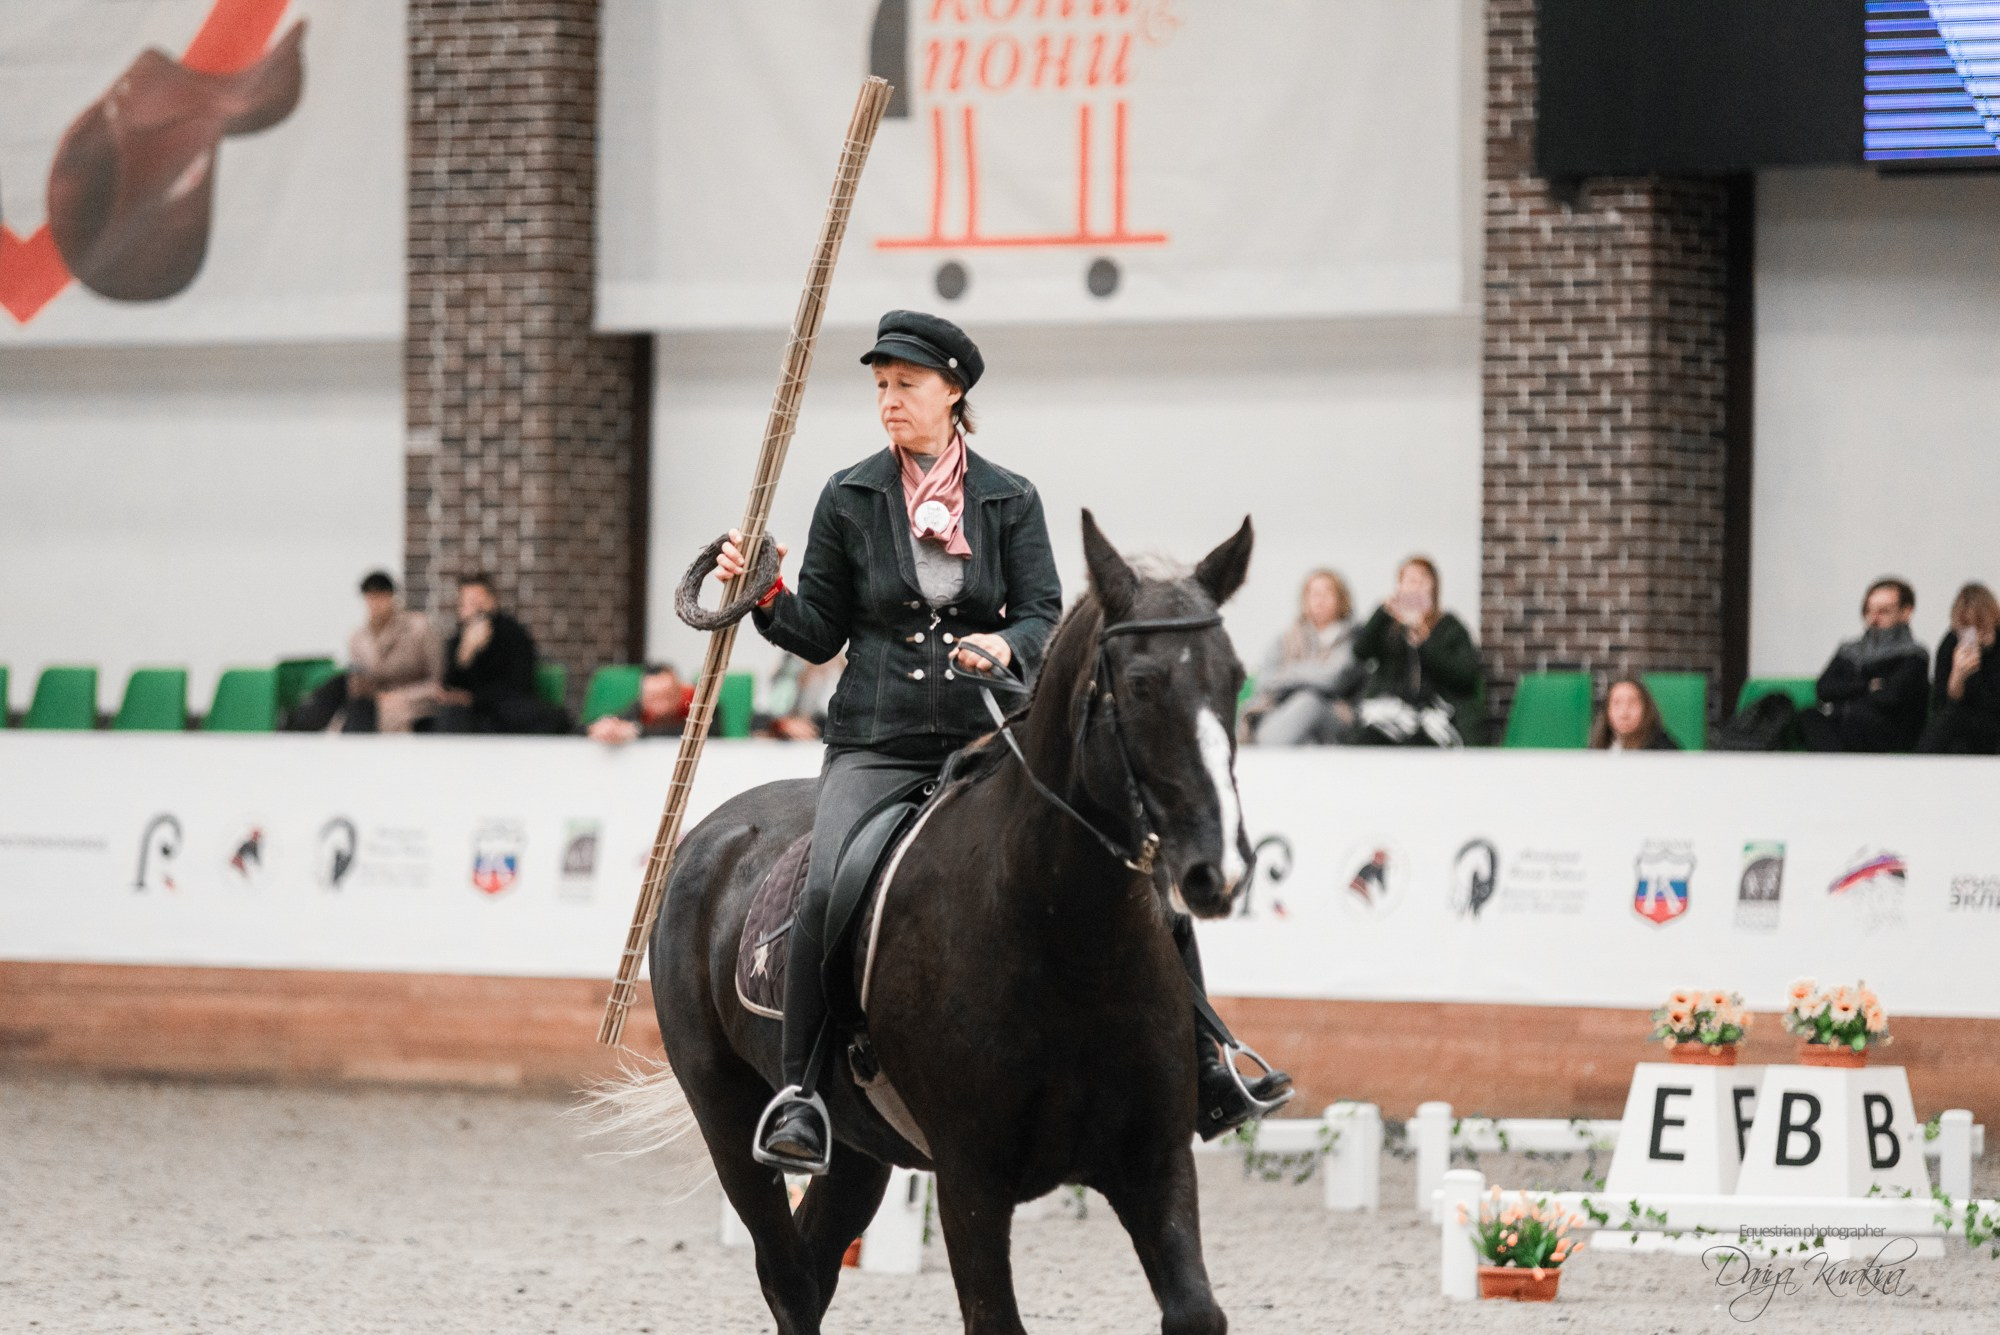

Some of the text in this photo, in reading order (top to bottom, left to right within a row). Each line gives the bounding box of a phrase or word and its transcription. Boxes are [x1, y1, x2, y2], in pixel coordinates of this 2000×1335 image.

[1649, 1087, 1692, 1161] E
[1775, 1092, 1822, 1167] B
[1863, 1094, 1901, 1169] B
